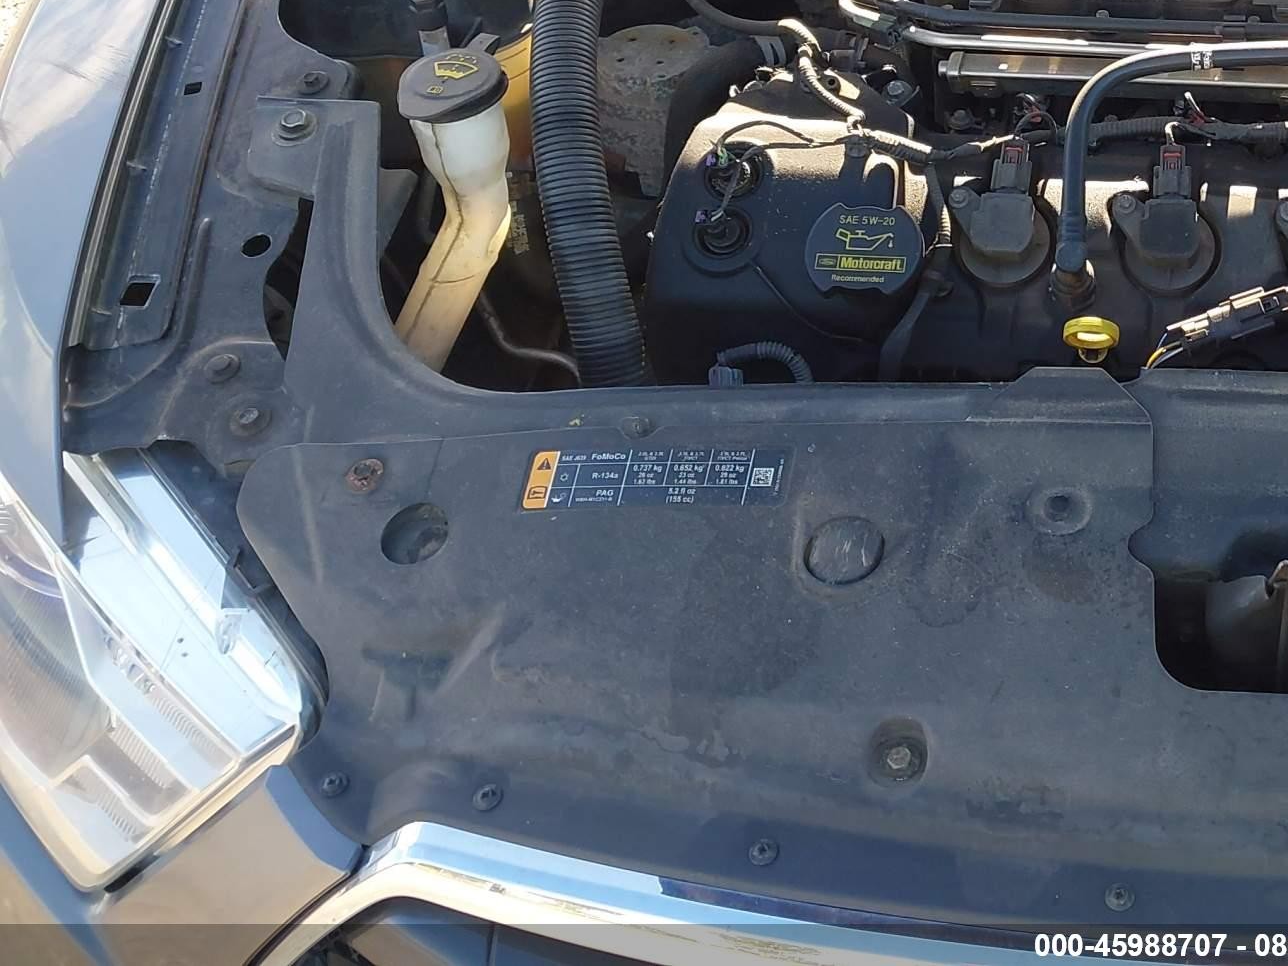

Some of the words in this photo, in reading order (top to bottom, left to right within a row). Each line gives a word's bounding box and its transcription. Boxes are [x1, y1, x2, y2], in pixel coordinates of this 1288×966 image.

[839, 215, 860, 225] SAE
[861, 216, 896, 226] 5W-20
[840, 257, 903, 271] Motorcraft
[831, 274, 885, 283] Recommended
[595, 489, 614, 497] PAG
